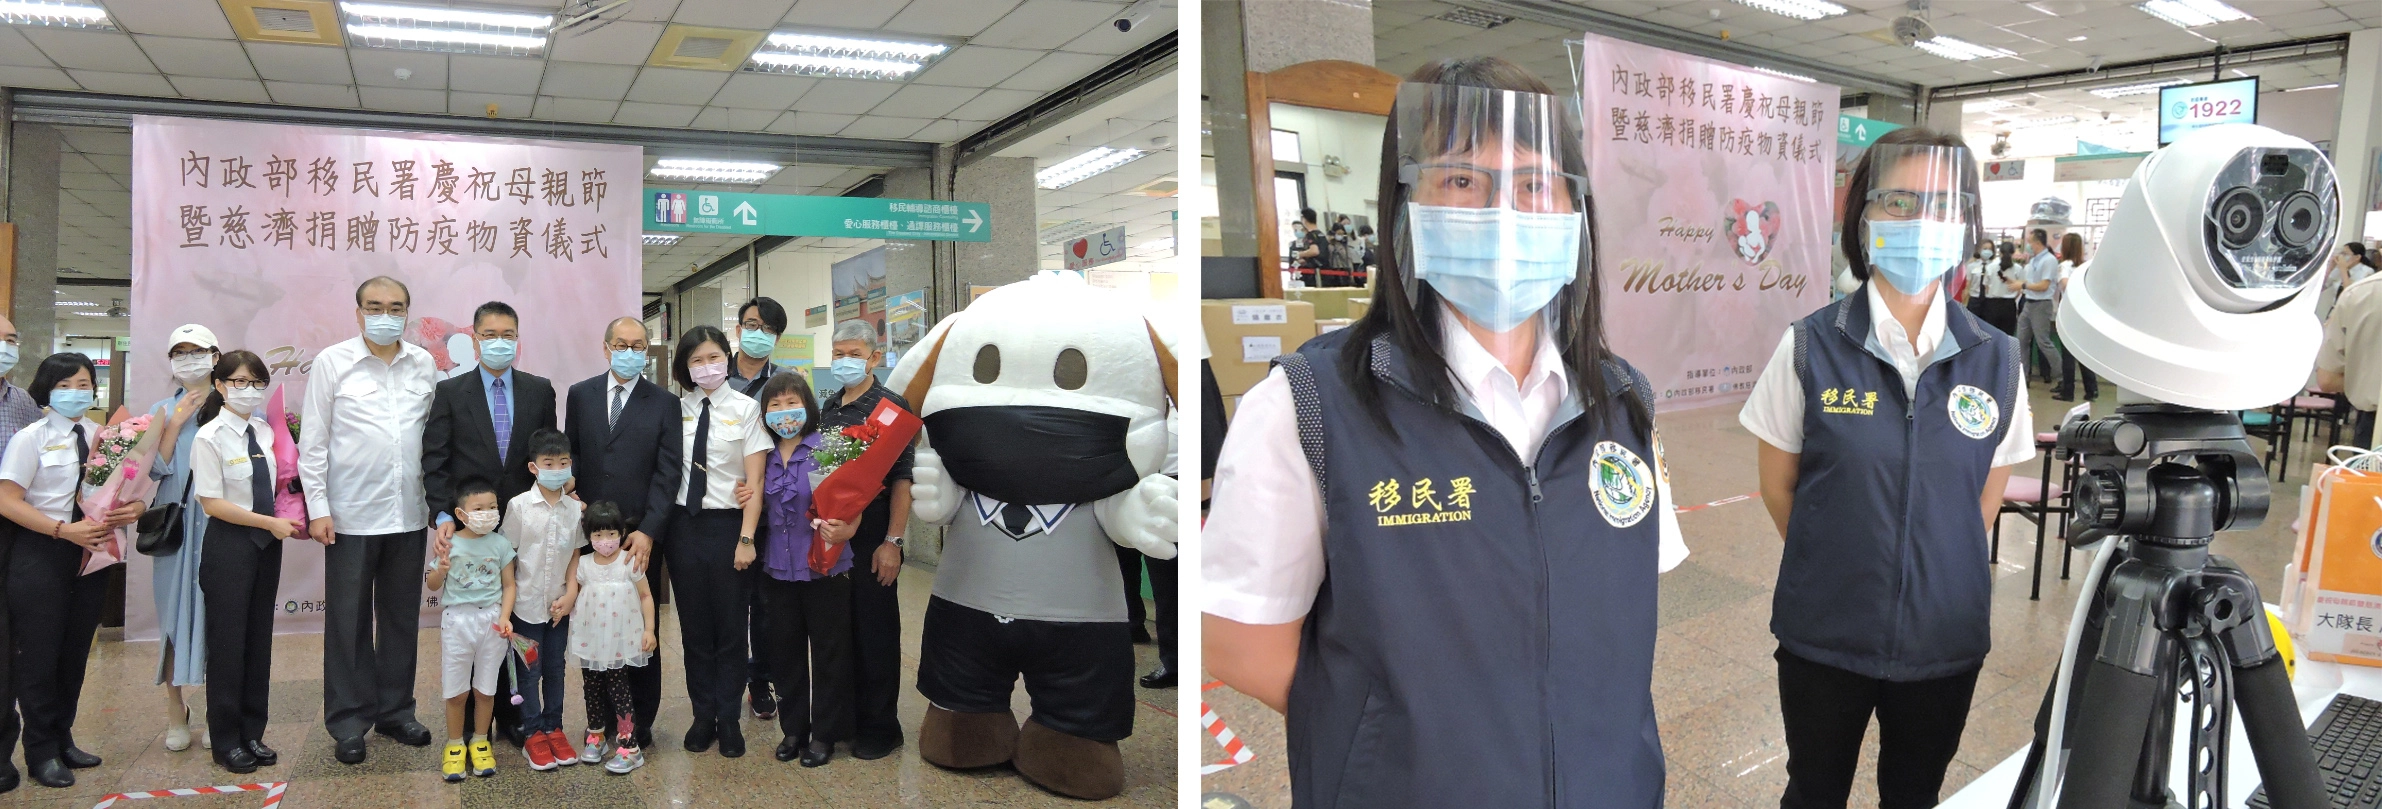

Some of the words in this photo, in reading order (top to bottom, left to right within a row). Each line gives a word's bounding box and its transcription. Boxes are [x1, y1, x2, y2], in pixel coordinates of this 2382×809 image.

[1611, 64, 1824, 131] 內政部移民署慶祝母親節
[2189, 99, 2242, 118] 1922
[1610, 107, 1822, 164] 暨慈濟捐贈防疫物資儀式
[180, 150, 608, 213] 內政部移民署慶祝母親節
[179, 204, 608, 263] 暨慈濟捐贈防疫物資儀式
[1657, 216, 1715, 243] Happy
[1620, 258, 1746, 294] Mother's
[1759, 259, 1808, 298] Day
[1820, 387, 1879, 409] 移民署
[1823, 405, 1874, 416] IMMIGRATION
[1368, 476, 1477, 513] 移民署
[1377, 510, 1472, 527] IMMIGRATION
[426, 595, 439, 608] 佛
[2316, 612, 2373, 633] 大隊長
